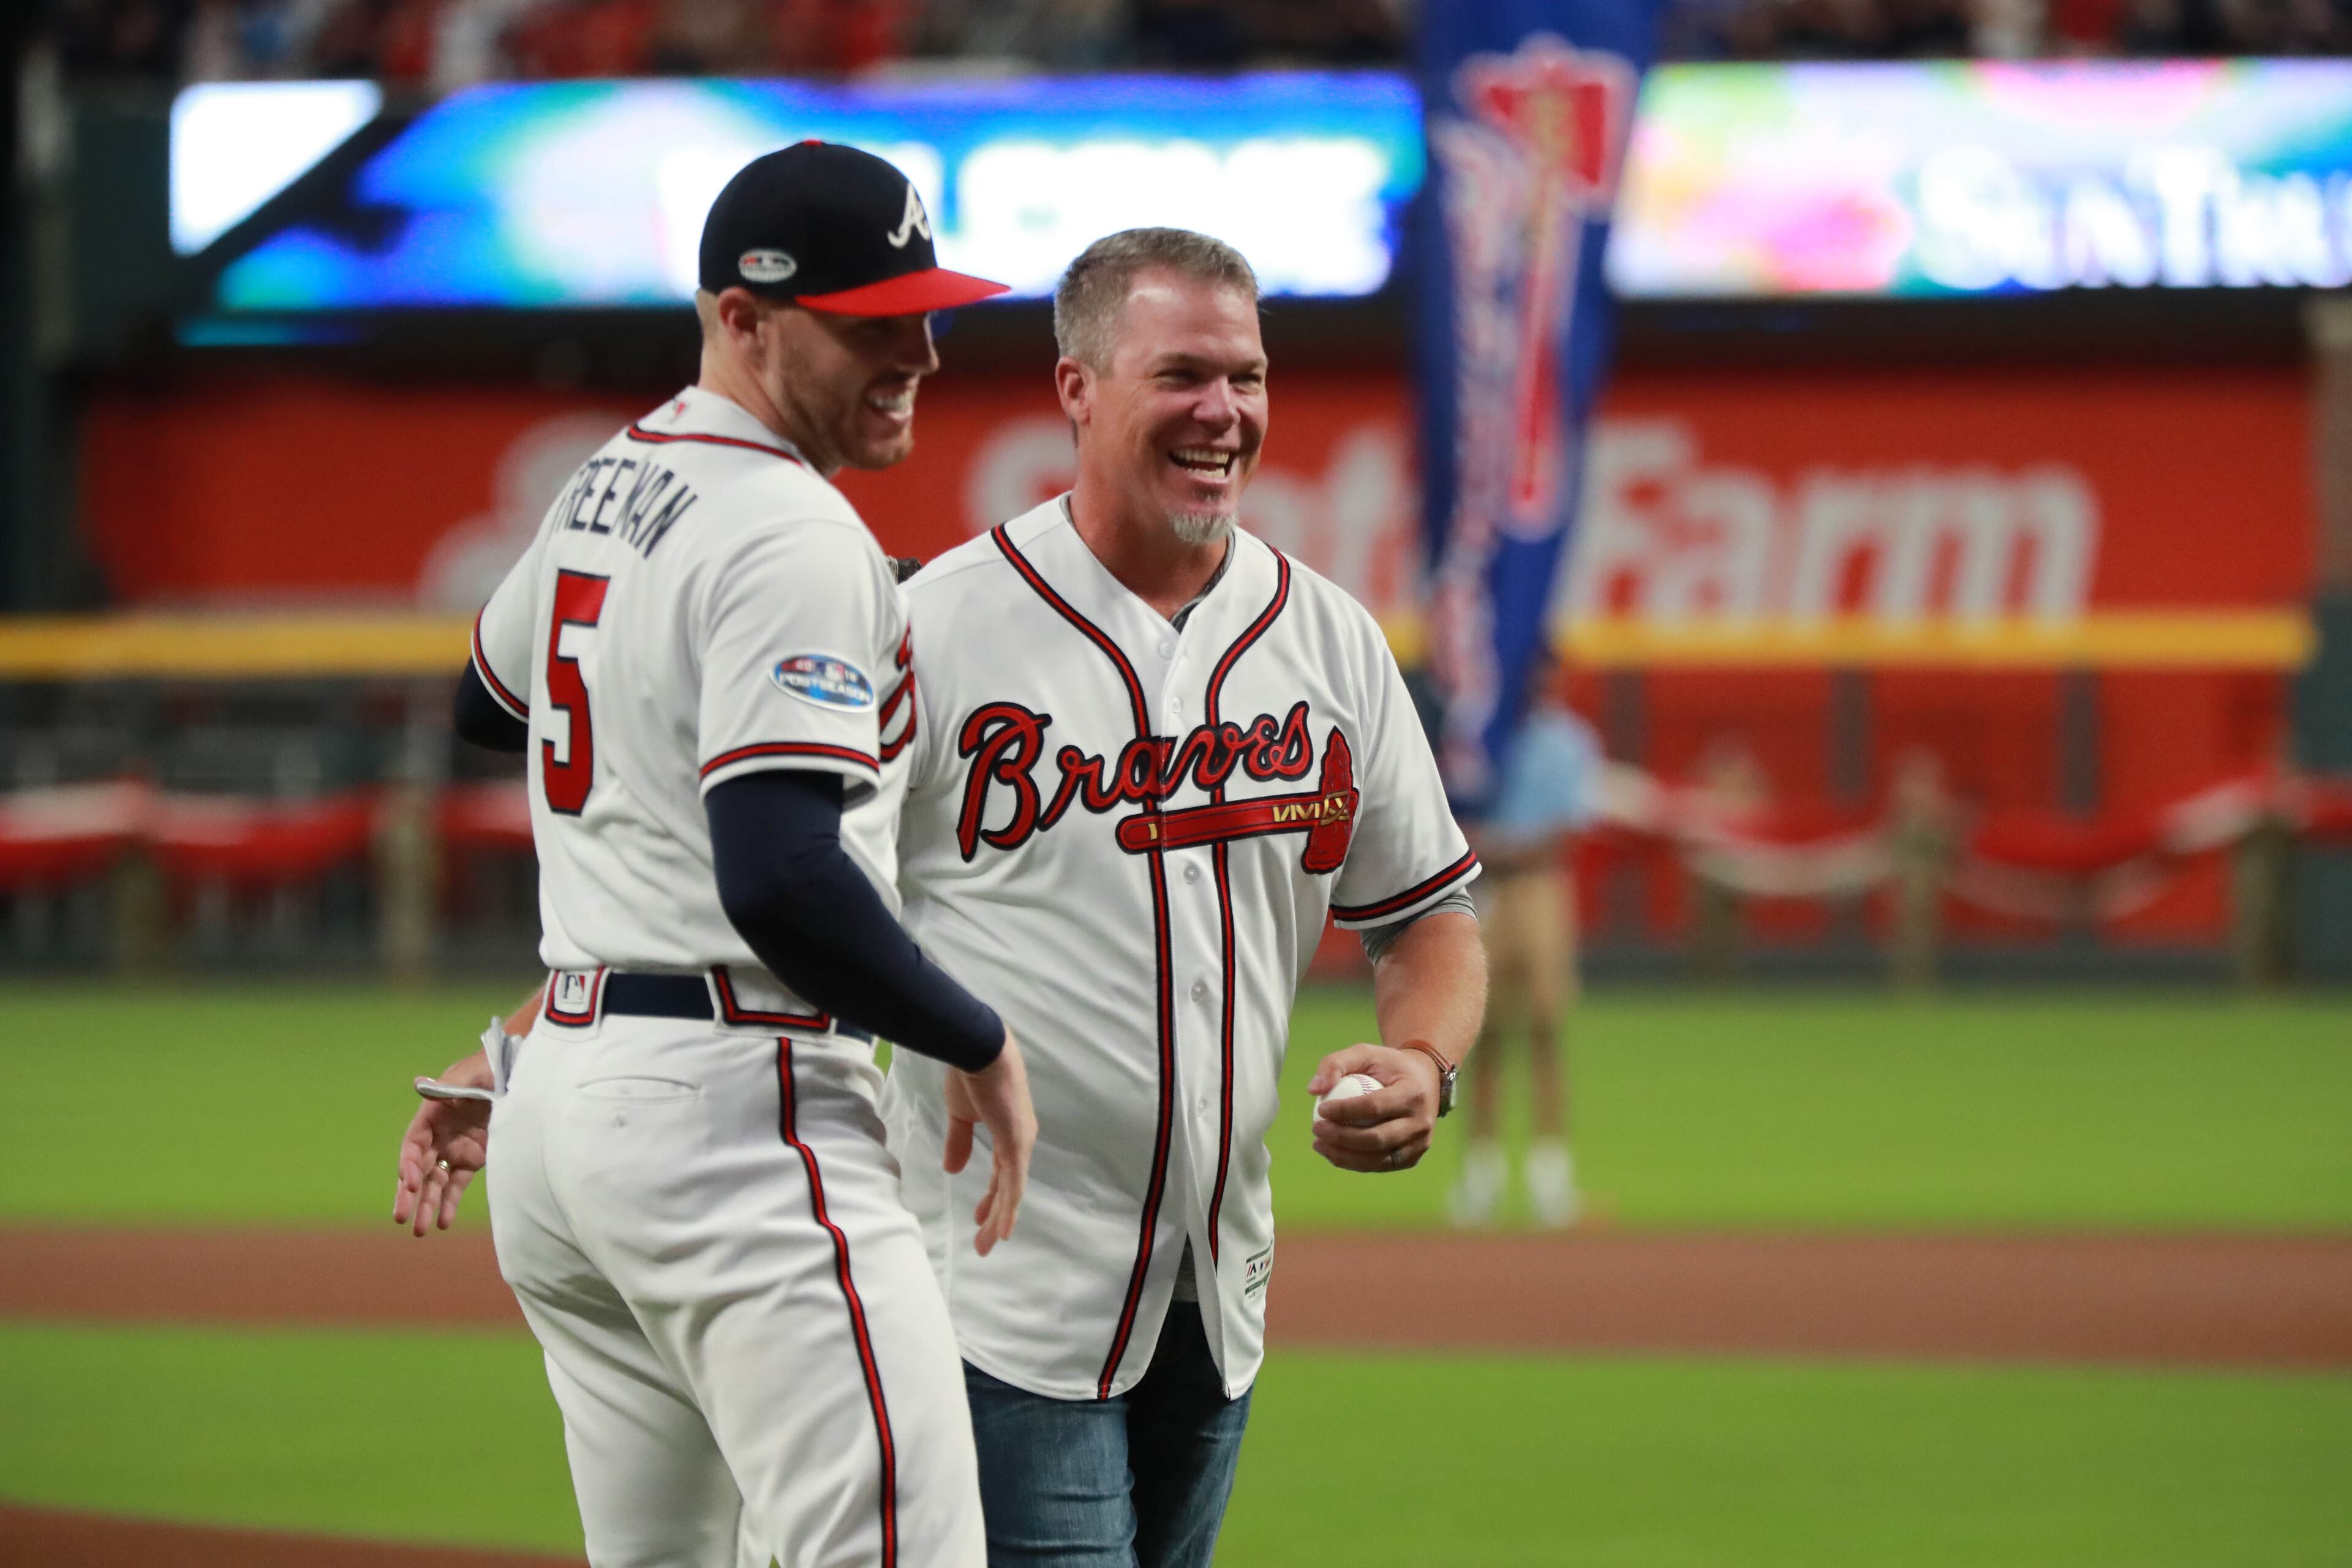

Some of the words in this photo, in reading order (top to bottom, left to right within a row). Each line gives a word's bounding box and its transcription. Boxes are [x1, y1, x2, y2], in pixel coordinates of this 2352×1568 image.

[888, 182, 930, 248] A
[1562, 420, 2098, 634] Farm
[541, 567, 611, 816] 5
[956, 701, 1311, 862] Braves
